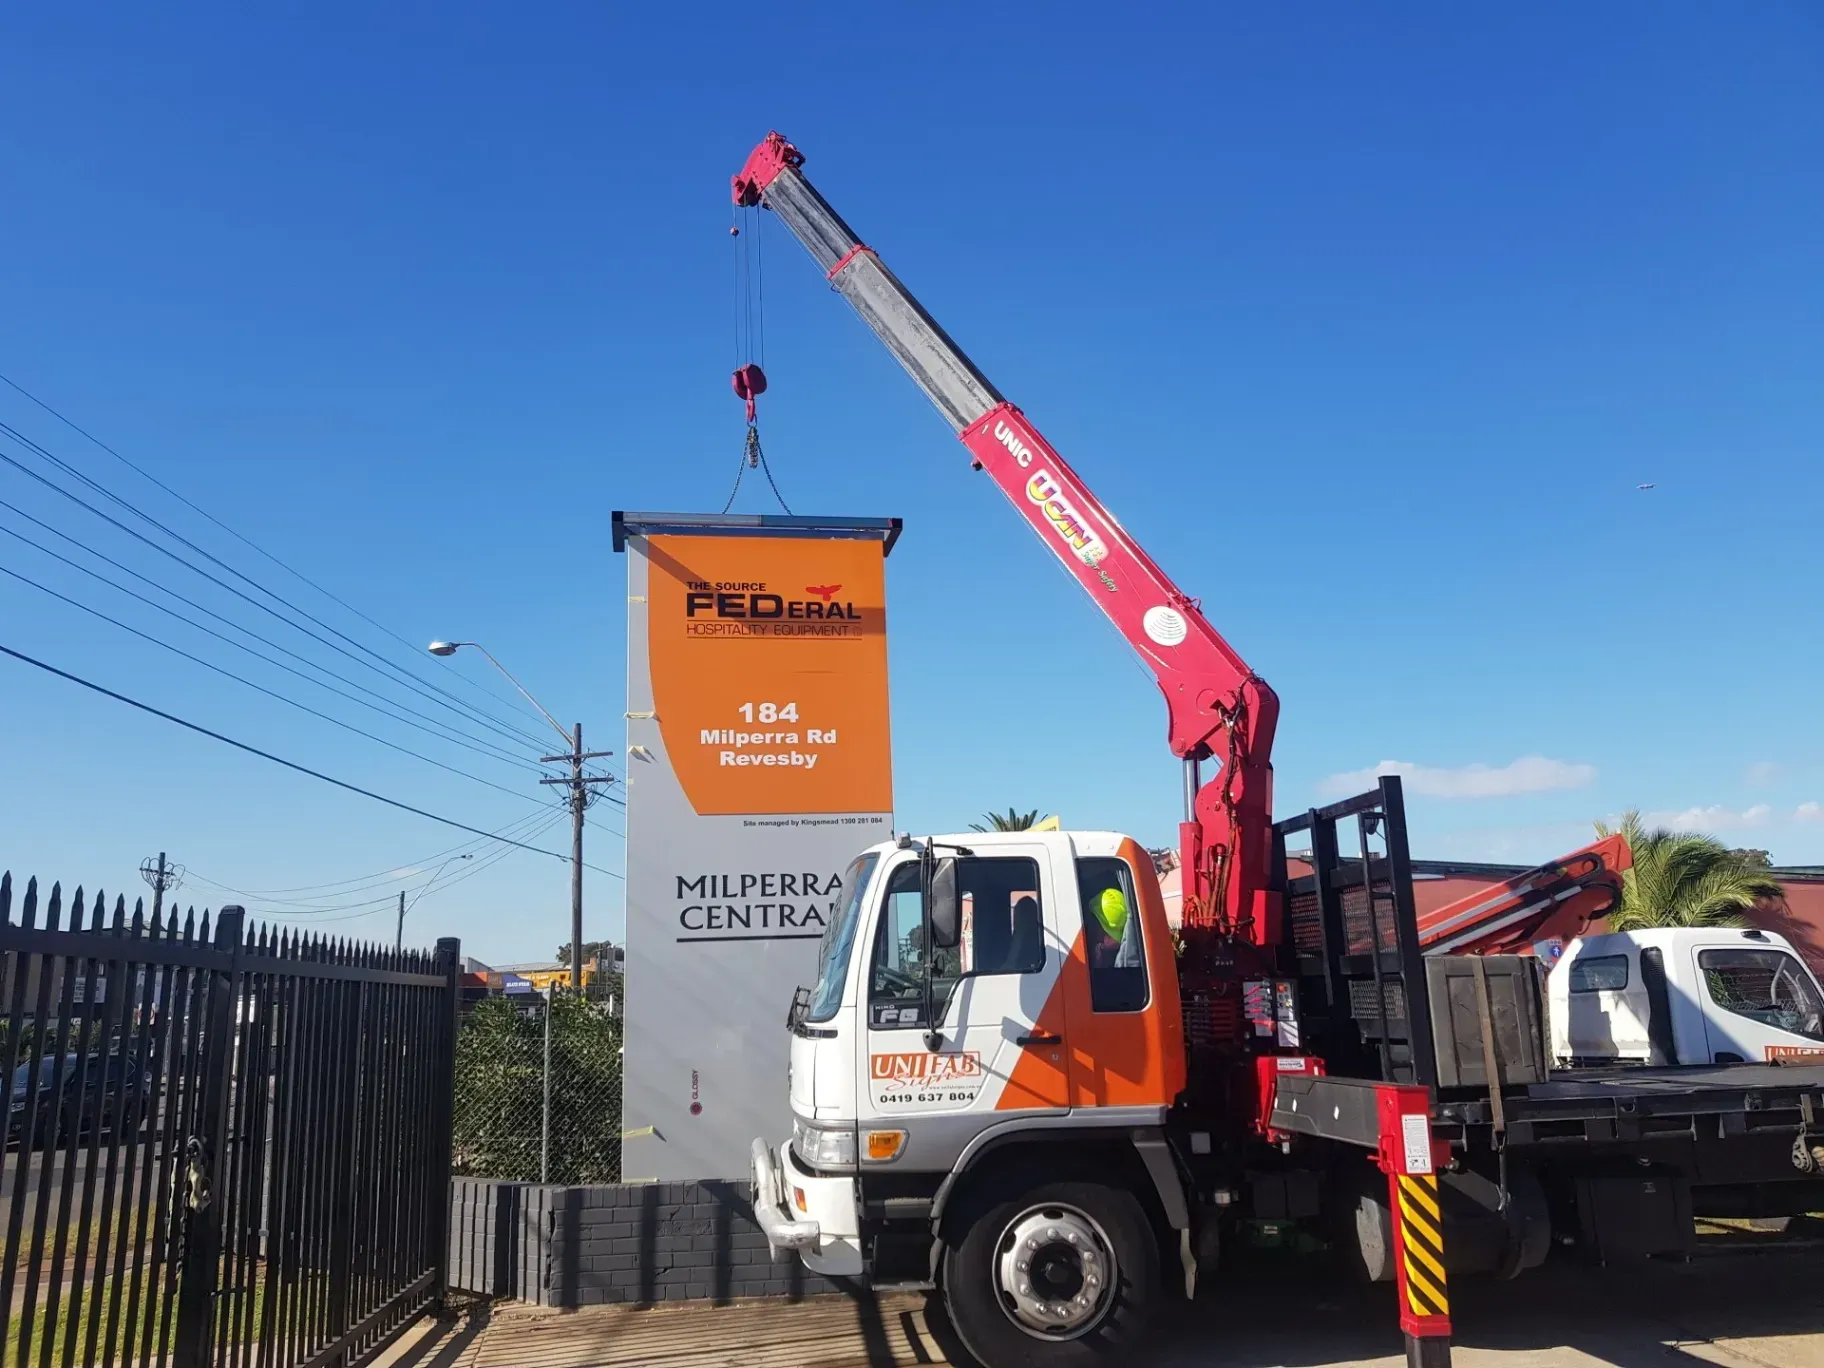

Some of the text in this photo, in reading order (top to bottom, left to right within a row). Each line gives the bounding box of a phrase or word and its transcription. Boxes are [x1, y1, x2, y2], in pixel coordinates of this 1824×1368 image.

[994, 420, 1033, 468] UNIC
[1028, 475, 1093, 550] UCAN
[686, 581, 767, 592] THE SOURCE
[686, 593, 862, 620] FEDERAL
[686, 623, 849, 637] HOSPITALITY EQUIPMENT
[738, 702, 799, 724] 184
[700, 729, 837, 748] Milperra Rd
[719, 750, 818, 769] Revesby
[758, 820, 789, 828] managed
[790, 819, 800, 827] by
[801, 818, 839, 827] Kingsmead
[840, 817, 856, 825] 1300
[675, 872, 843, 900] MILPERRA
[874, 1053, 976, 1078] UNIFAB
[880, 1092, 975, 1103] 0419 637 804
